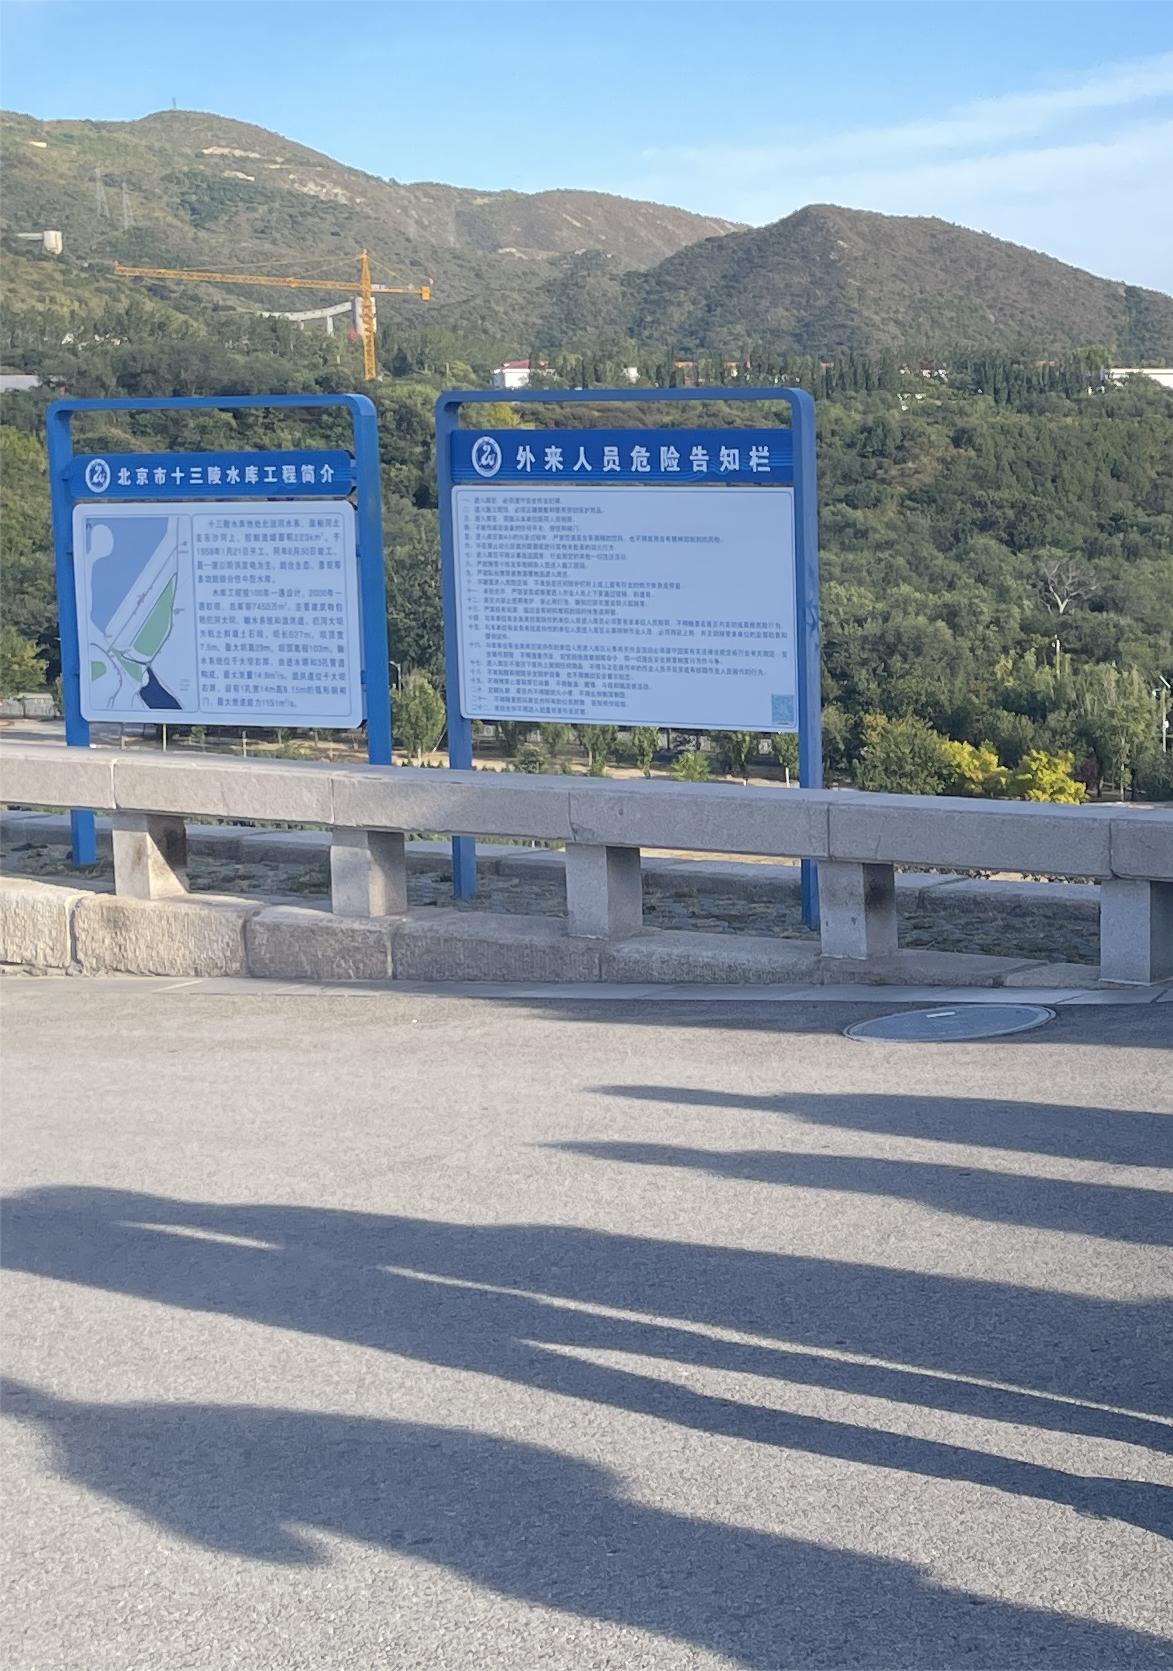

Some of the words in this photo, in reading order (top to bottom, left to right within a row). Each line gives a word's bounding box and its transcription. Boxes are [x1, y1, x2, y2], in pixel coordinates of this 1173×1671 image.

[516, 445, 771, 473] 外来人员危险告知栏
[117, 463, 335, 487] 北京市十三陵水库工程简介
